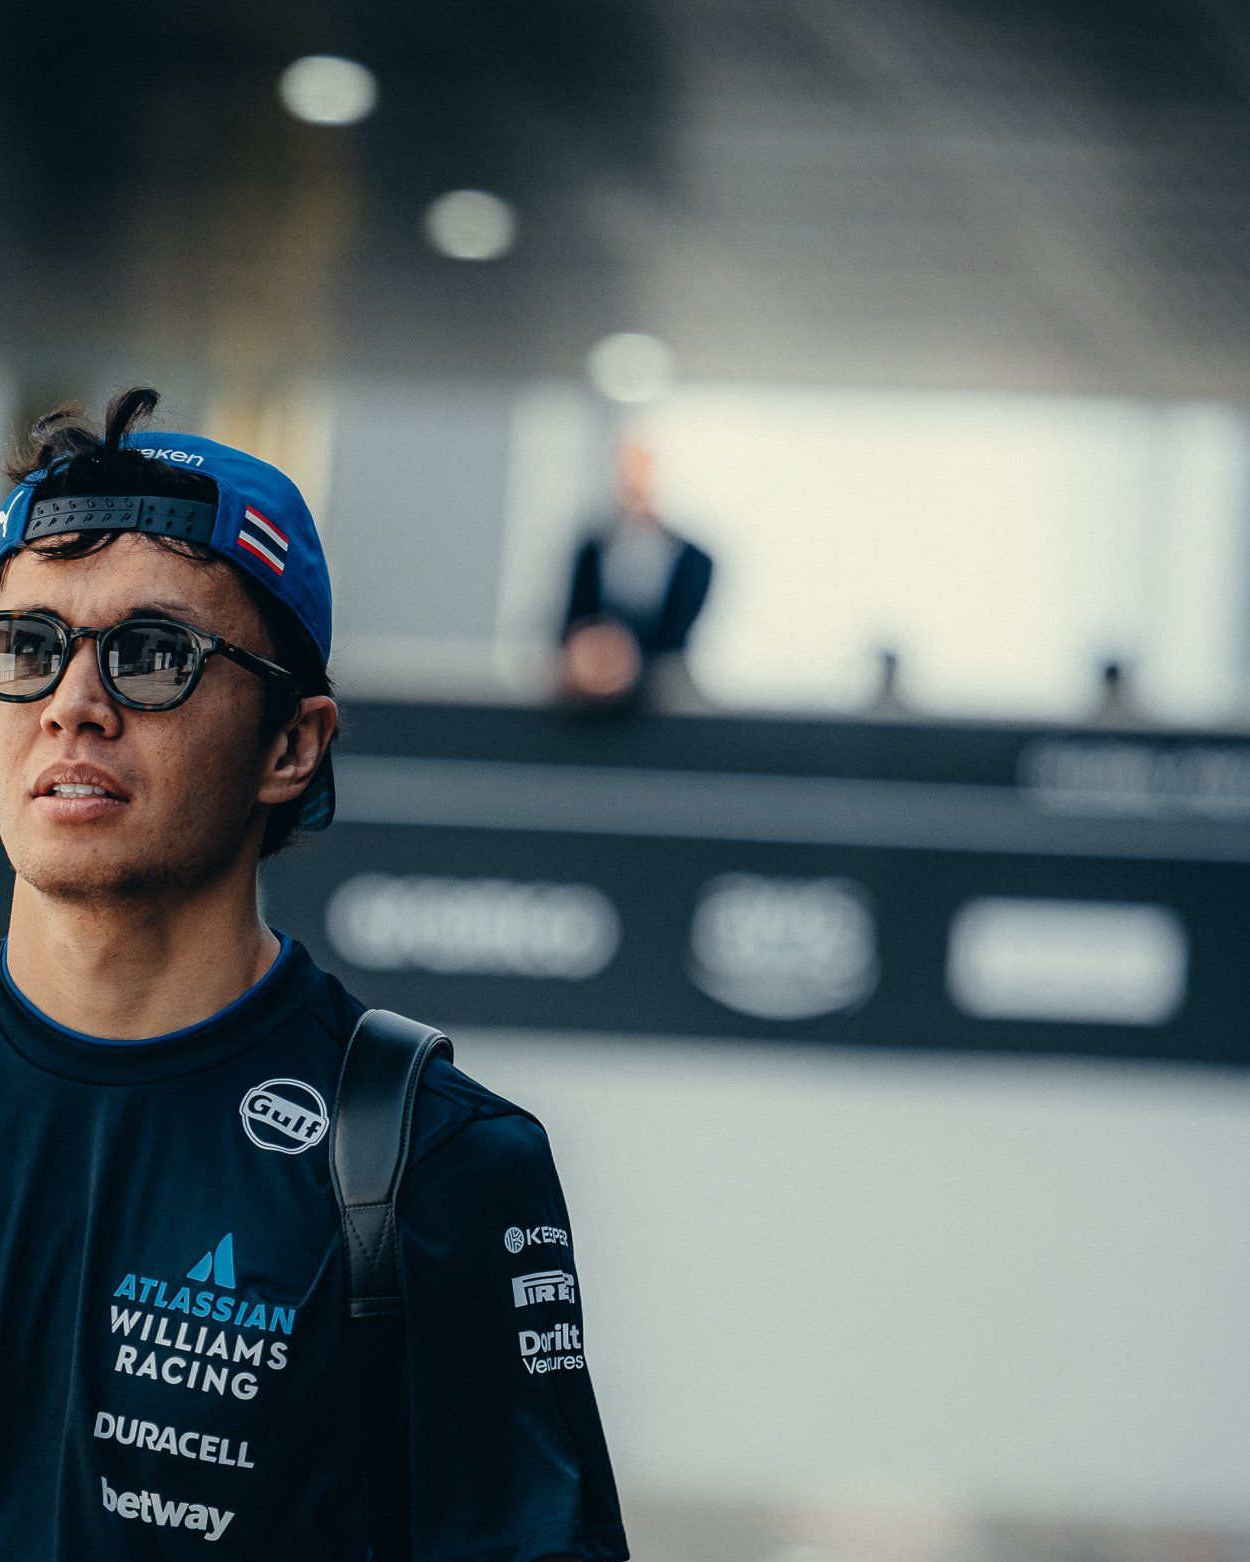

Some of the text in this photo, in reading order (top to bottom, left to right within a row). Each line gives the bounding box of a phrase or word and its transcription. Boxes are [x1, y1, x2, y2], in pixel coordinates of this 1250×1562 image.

[127, 448, 205, 467] aken
[247, 1094, 322, 1141] Gulf
[113, 1273, 297, 1335] ATLASSIAN
[110, 1305, 289, 1371] WILLIAMS
[114, 1344, 259, 1401] RACING
[93, 1410, 256, 1469] DURACELL
[100, 1474, 236, 1542] betway
